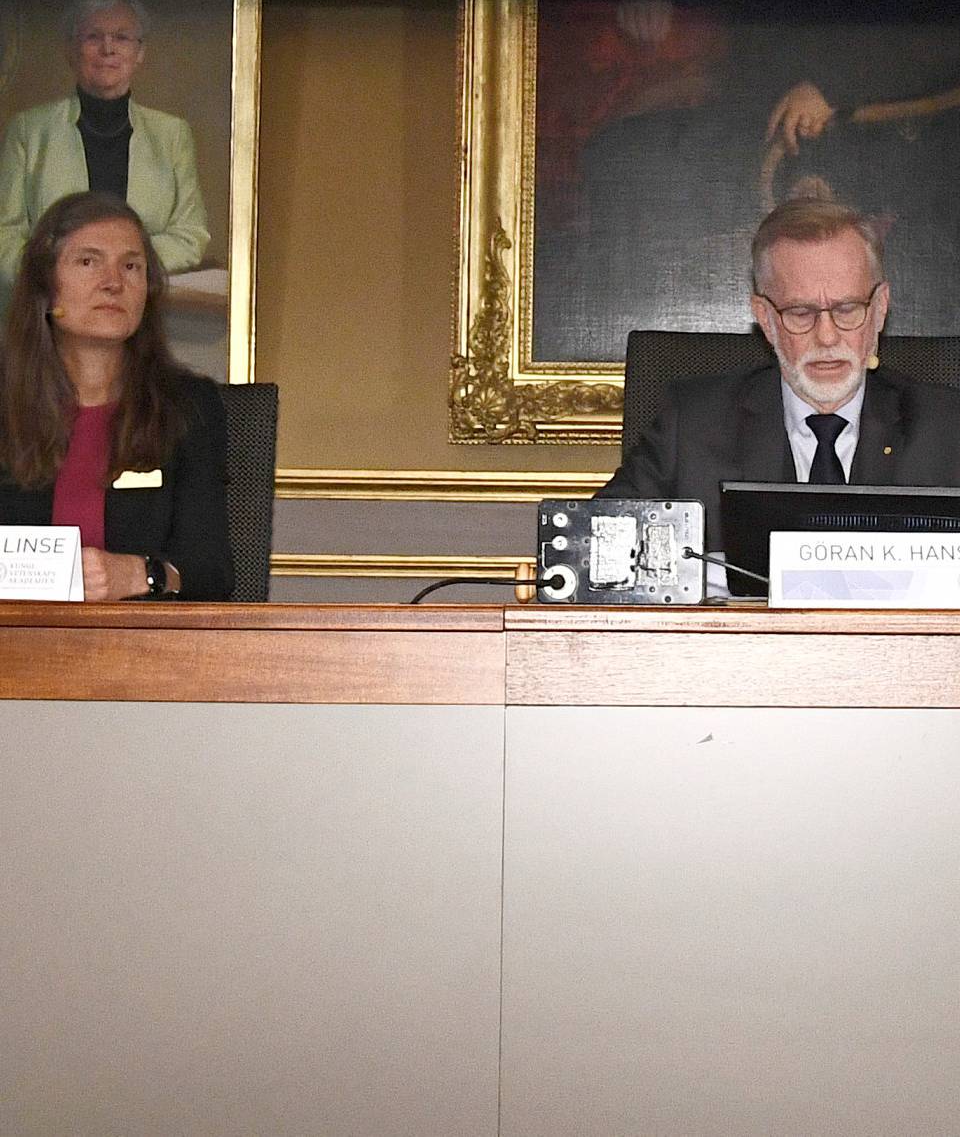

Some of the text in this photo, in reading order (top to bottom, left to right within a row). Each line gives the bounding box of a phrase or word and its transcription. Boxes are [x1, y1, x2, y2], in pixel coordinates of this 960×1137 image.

[4, 538, 66, 553] LINSE
[800, 541, 874, 561] GÖRAN
[883, 544, 901, 561] K.
